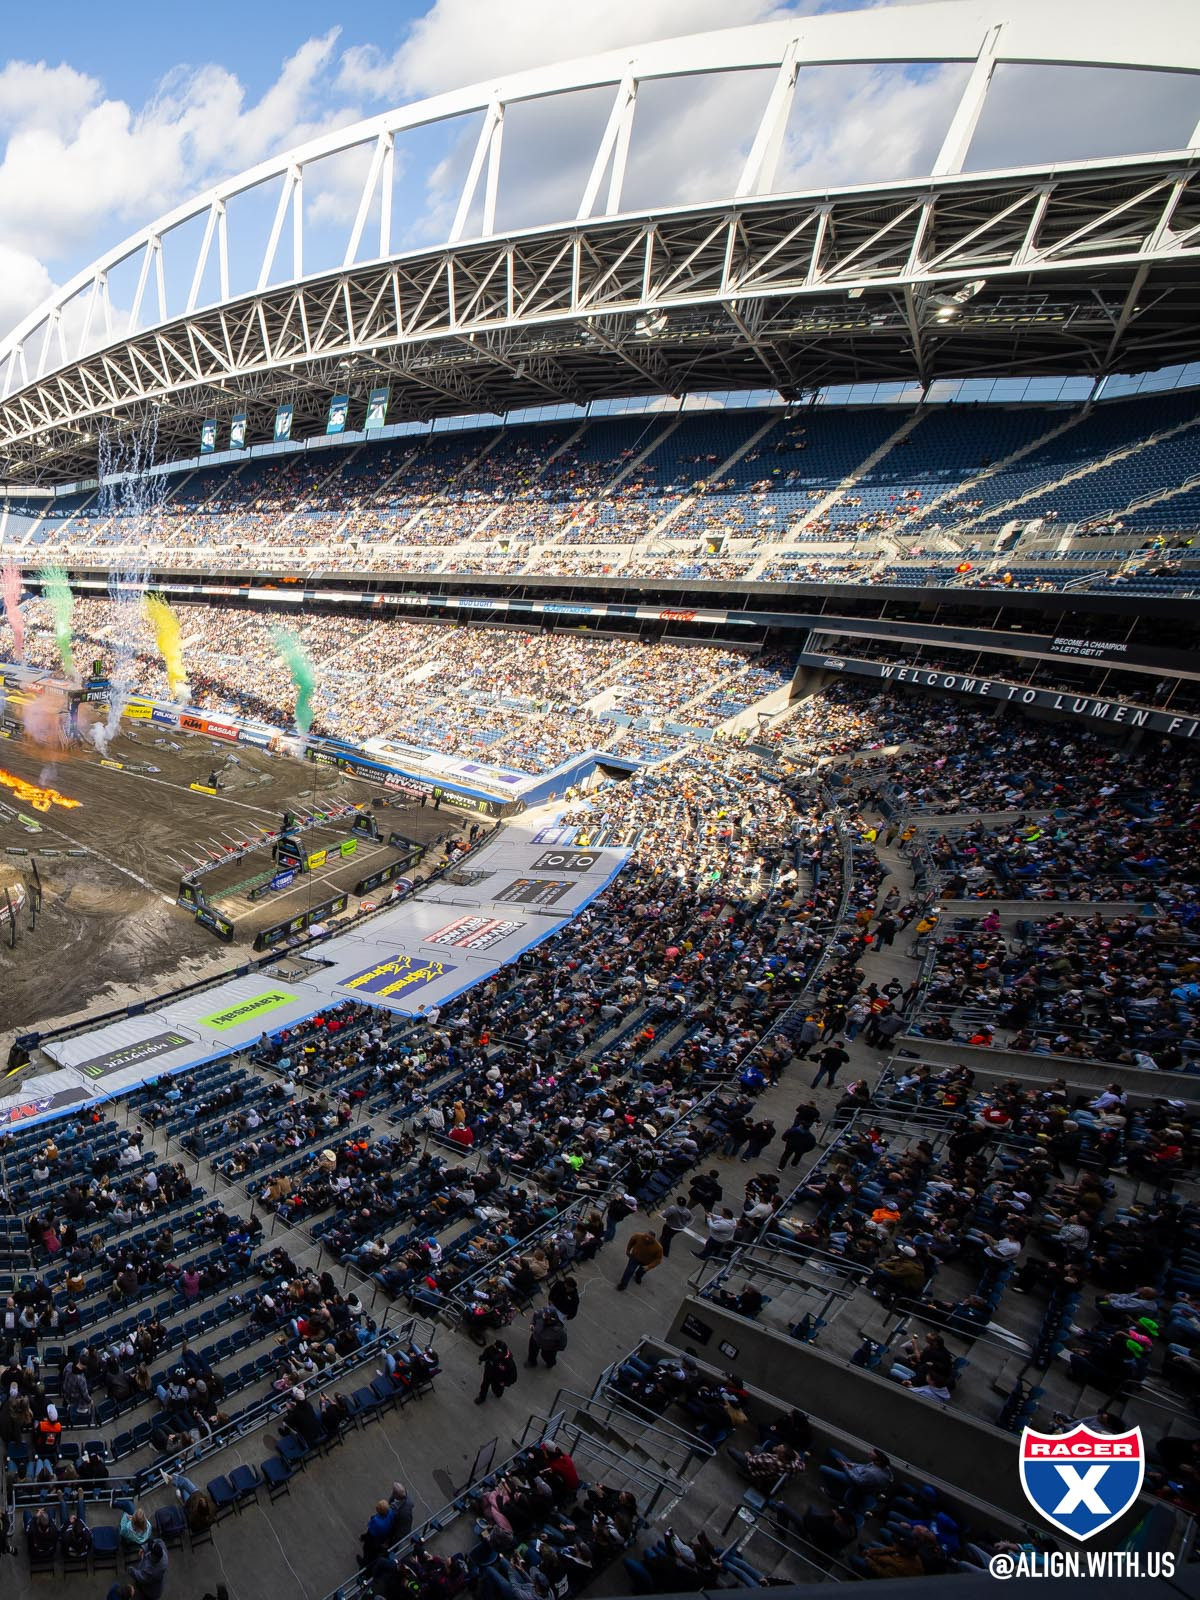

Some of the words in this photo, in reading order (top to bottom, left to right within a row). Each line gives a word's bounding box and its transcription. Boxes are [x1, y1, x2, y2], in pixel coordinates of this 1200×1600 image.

[329, 410, 345, 426] 36
[388, 596, 422, 605] DELTA
[659, 609, 698, 622] Coca-Cola
[1054, 637, 1084, 648] BECOME
[1059, 646, 1080, 654] LET'S
[1080, 648, 1095, 656] GET
[1094, 649, 1104, 657] IT
[86, 690, 112, 702] FINISH
[880, 665, 992, 696] WELCOME
[1007, 686, 1037, 704] TO
[1053, 695, 1150, 727] LUMEN
[153, 710, 179, 721] FALKEN
[183, 718, 202, 730] KTM
[207, 724, 237, 737] GASGAS
[368, 768, 386, 778] SPORTS
[443, 791, 477, 807] MONSTER
[210, 994, 286, 1026] Kawasaki
[103, 1042, 169, 1068] MONSTER
